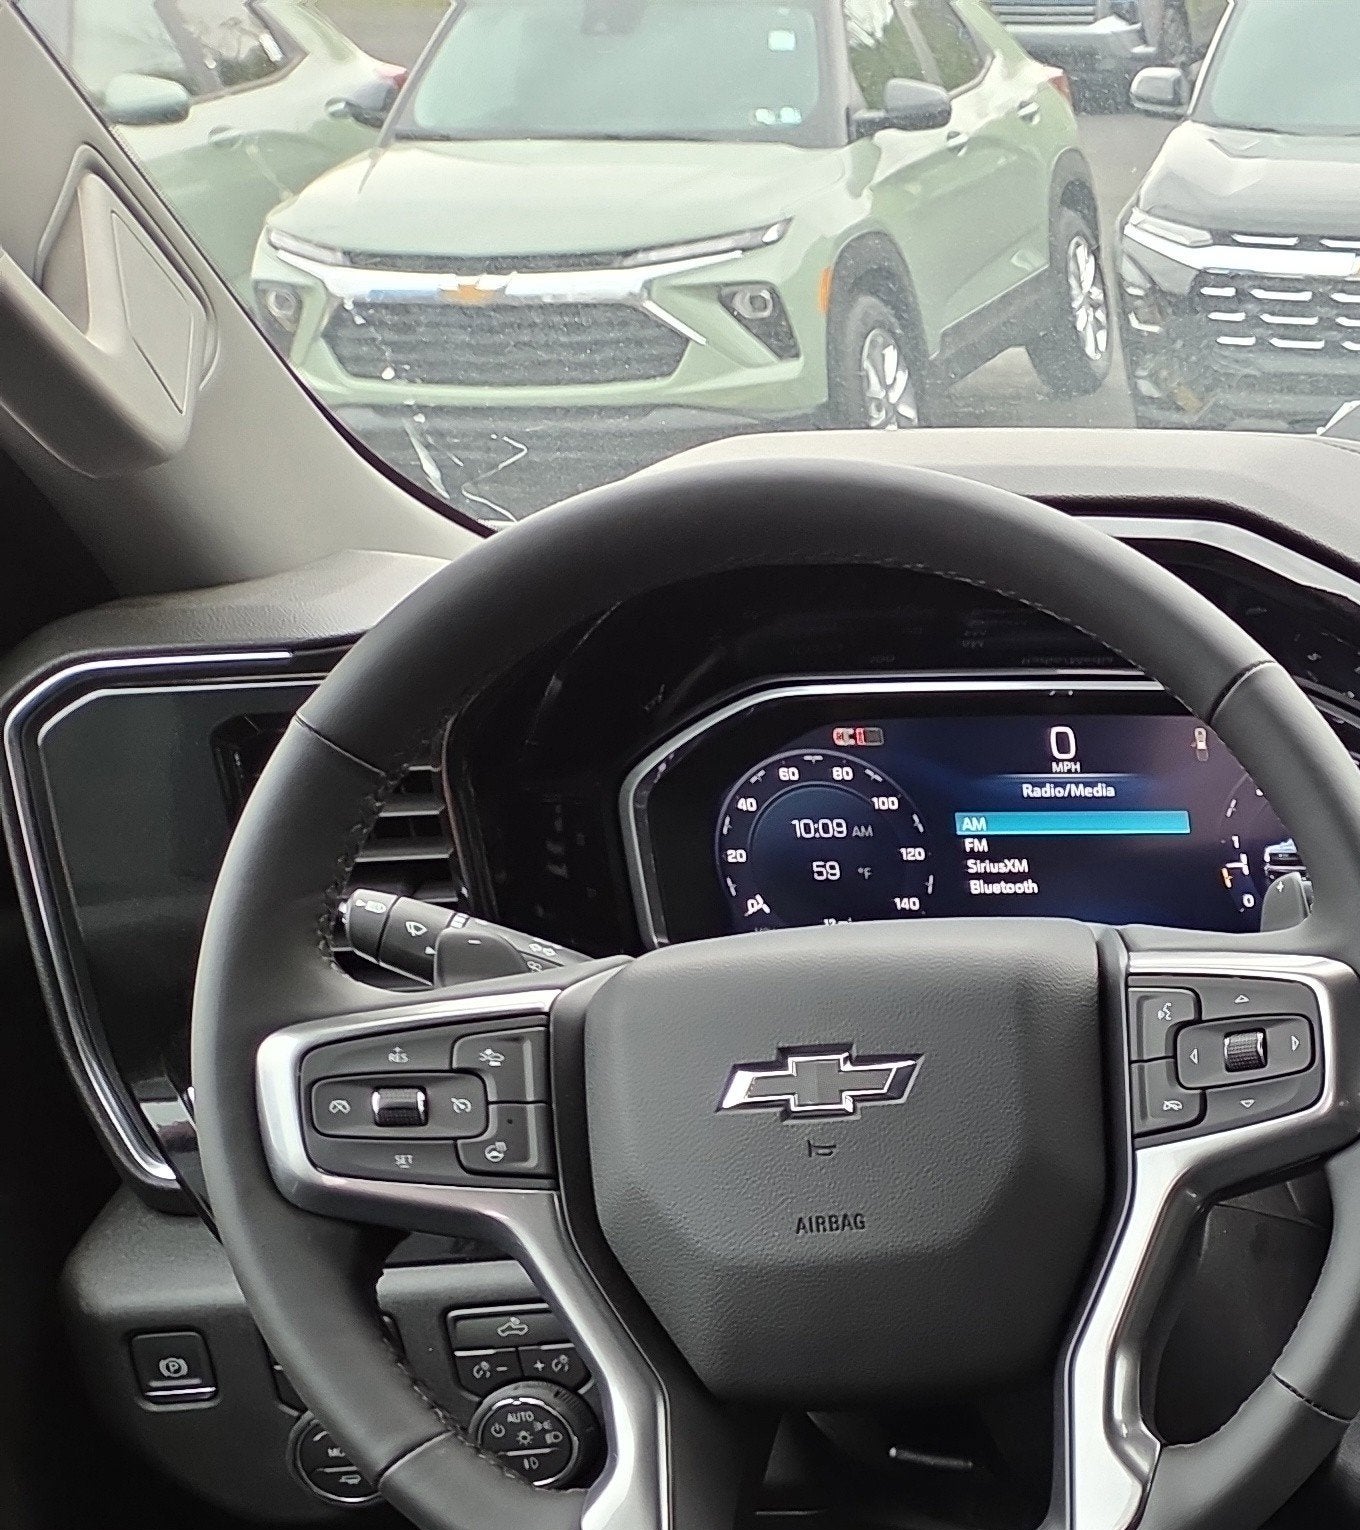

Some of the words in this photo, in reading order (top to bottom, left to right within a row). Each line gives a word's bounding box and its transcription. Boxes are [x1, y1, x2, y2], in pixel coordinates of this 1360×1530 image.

[1050, 726, 1077, 760] 0
[777, 766, 800, 781] 60
[832, 766, 854, 781] 80
[1051, 761, 1081, 773] MPH
[1022, 783, 1116, 799] Radio/Media
[737, 797, 757, 812] 40
[871, 796, 899, 811] 100
[790, 818, 848, 839] 10:09
[852, 824, 874, 837] AM
[962, 817, 987, 831] AM
[964, 838, 989, 853] FM
[726, 849, 747, 863] 20
[899, 847, 926, 861] 120
[811, 861, 841, 881] 59
[967, 859, 1029, 874] SiriusXM
[969, 879, 1039, 895] Bluetooth
[894, 897, 921, 911] 140
[1242, 893, 1255, 908] 0
[795, 1213, 866, 1235] AIRBAG
[506, 1410, 535, 1423] AUTO
